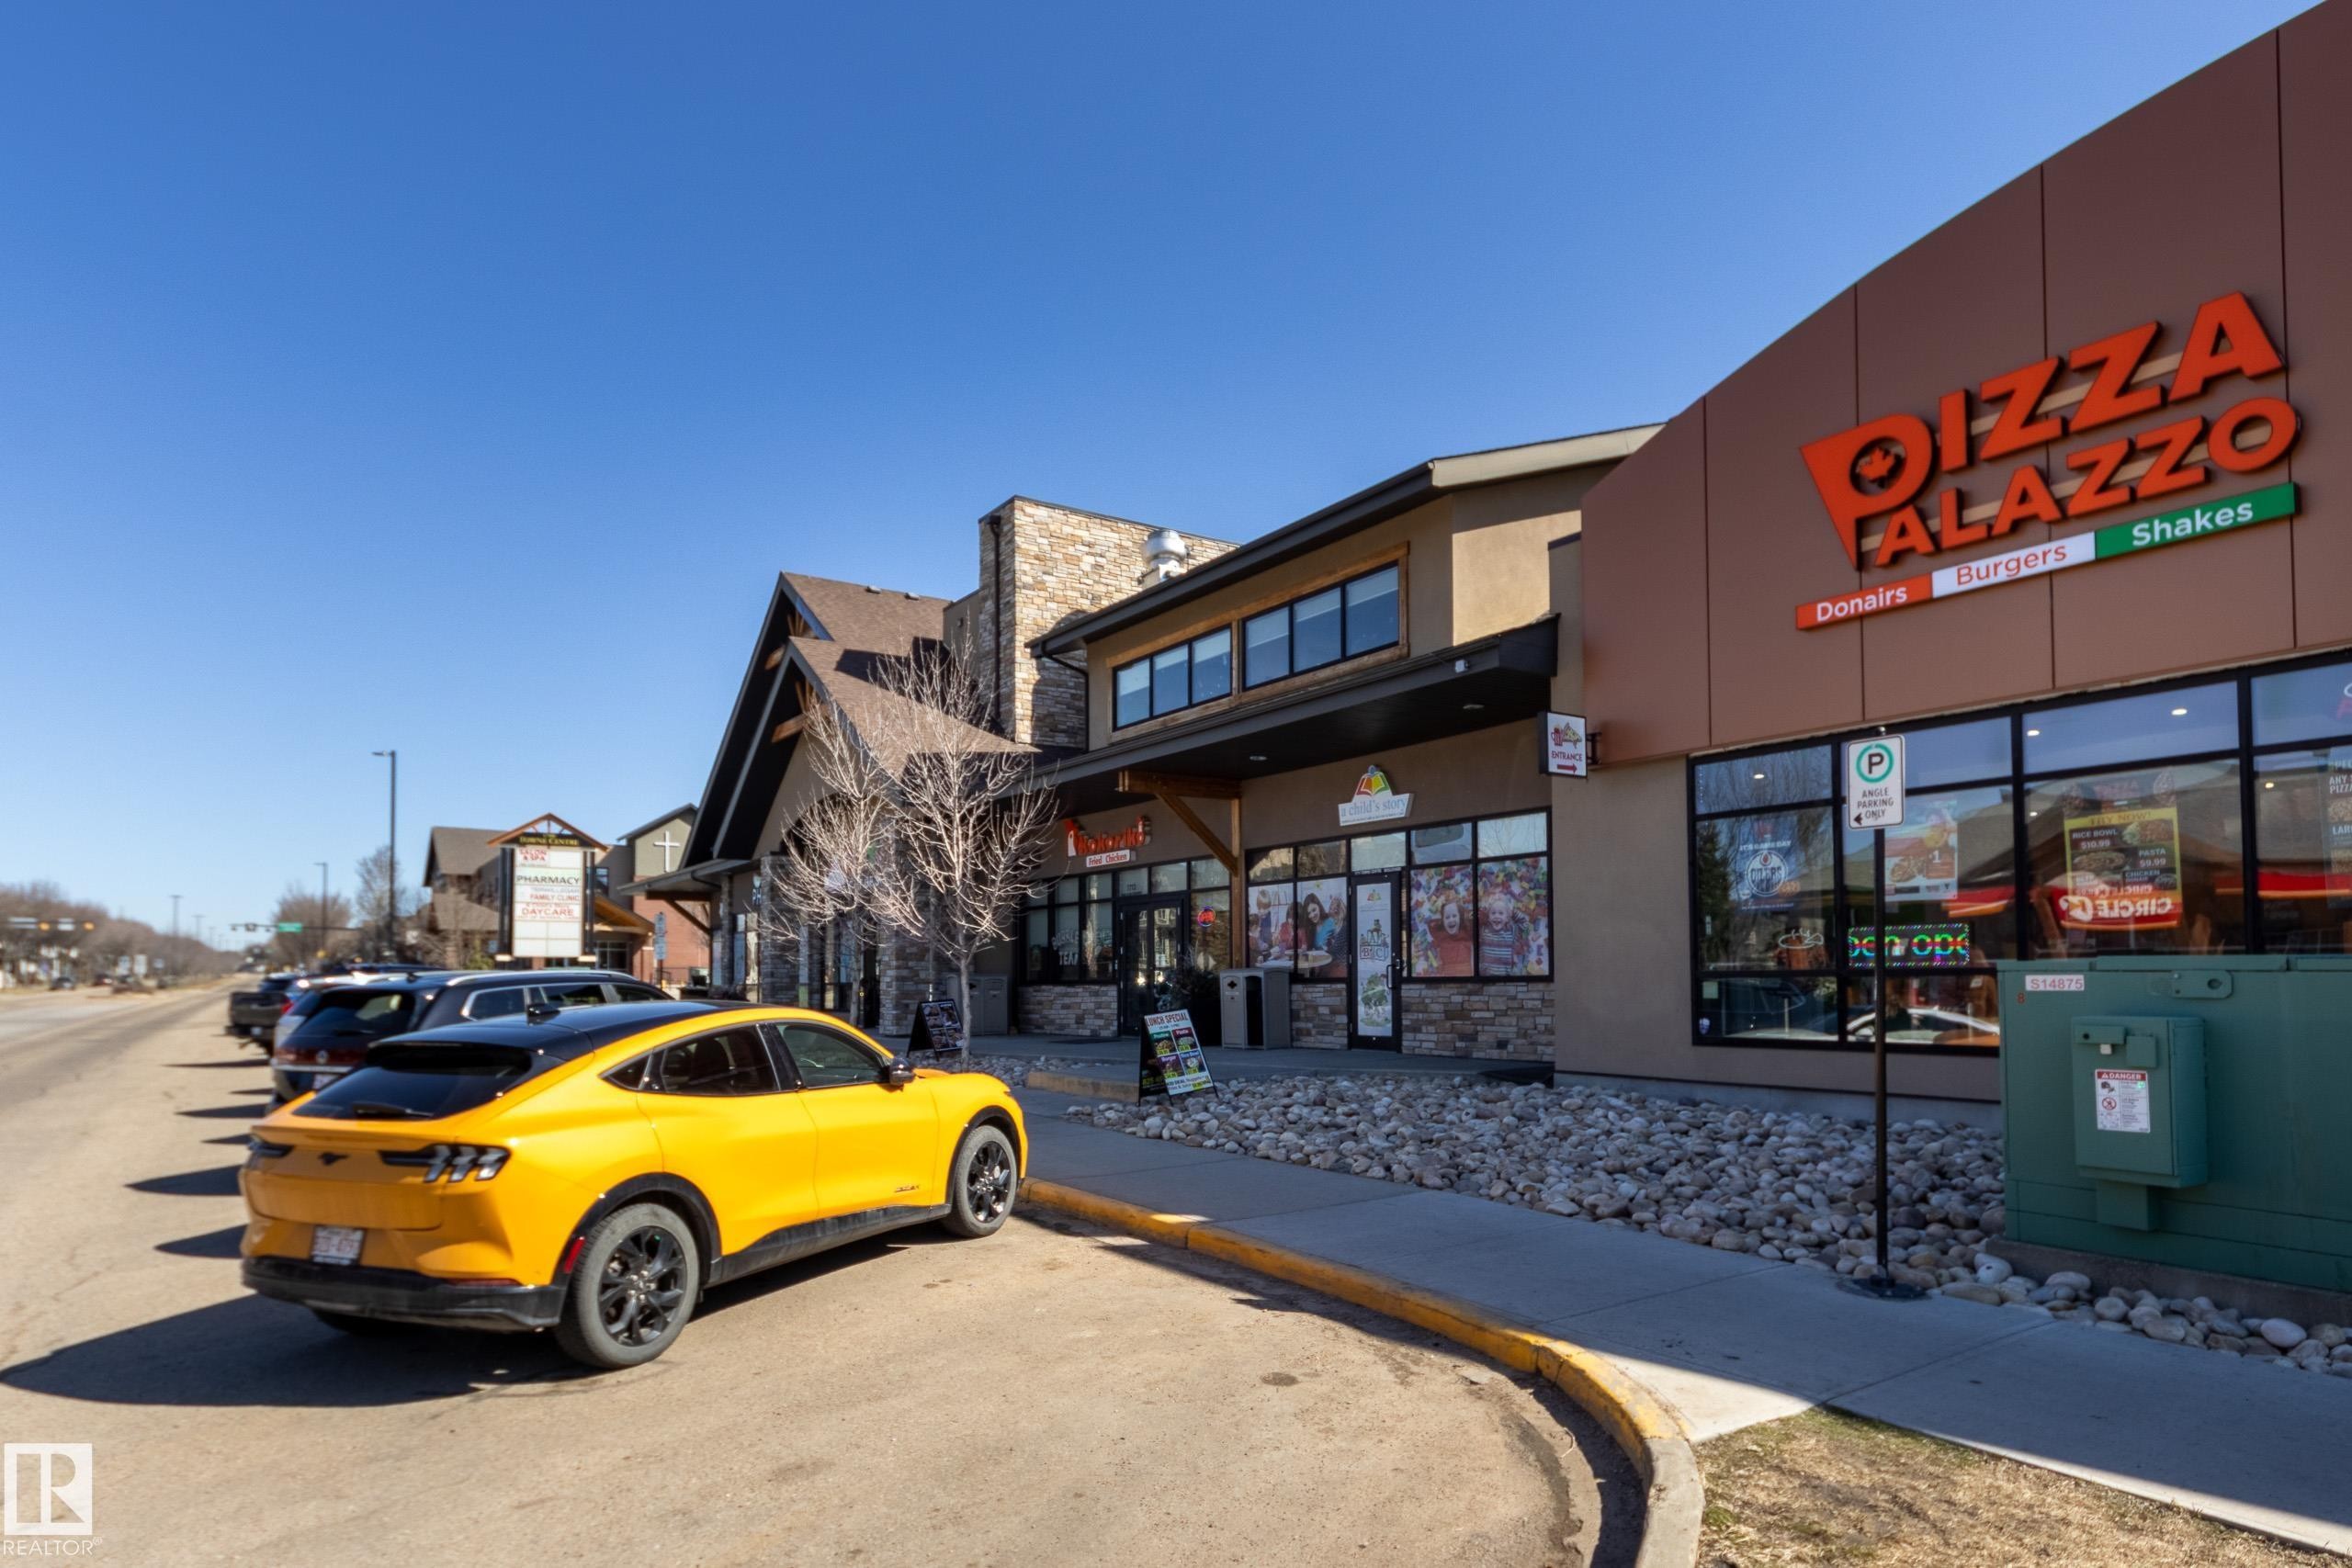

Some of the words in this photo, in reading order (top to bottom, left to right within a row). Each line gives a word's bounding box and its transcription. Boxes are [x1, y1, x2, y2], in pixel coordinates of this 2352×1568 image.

[1799, 291, 2287, 570] PIZZA
[1815, 584, 1908, 623] Donairs
[1955, 544, 2068, 587] Burgers
[2132, 501, 2254, 547] Shakes
[1551, 750, 1583, 762] ENTRANCE
[1868, 752, 1884, 775] P
[1861, 787, 1890, 799] ANGLE
[1857, 797, 1894, 809] PARKING
[1864, 809, 1886, 820] ONLY
[2072, 829, 2091, 840] RICE
[2093, 828, 2118, 838] BOWL
[2080, 840, 2110, 850] $10.99
[1089, 855, 1102, 865] Fried
[1105, 852, 1127, 863] Chicken
[2139, 848, 2166, 858] PASTA
[2139, 857, 2166, 868] $9.99
[516, 875, 580, 885] PHARMACY
[521, 908, 574, 916] DAYCARE
[2030, 978, 2084, 990] S14875
[2109, 1072, 2142, 1081] DANGER
